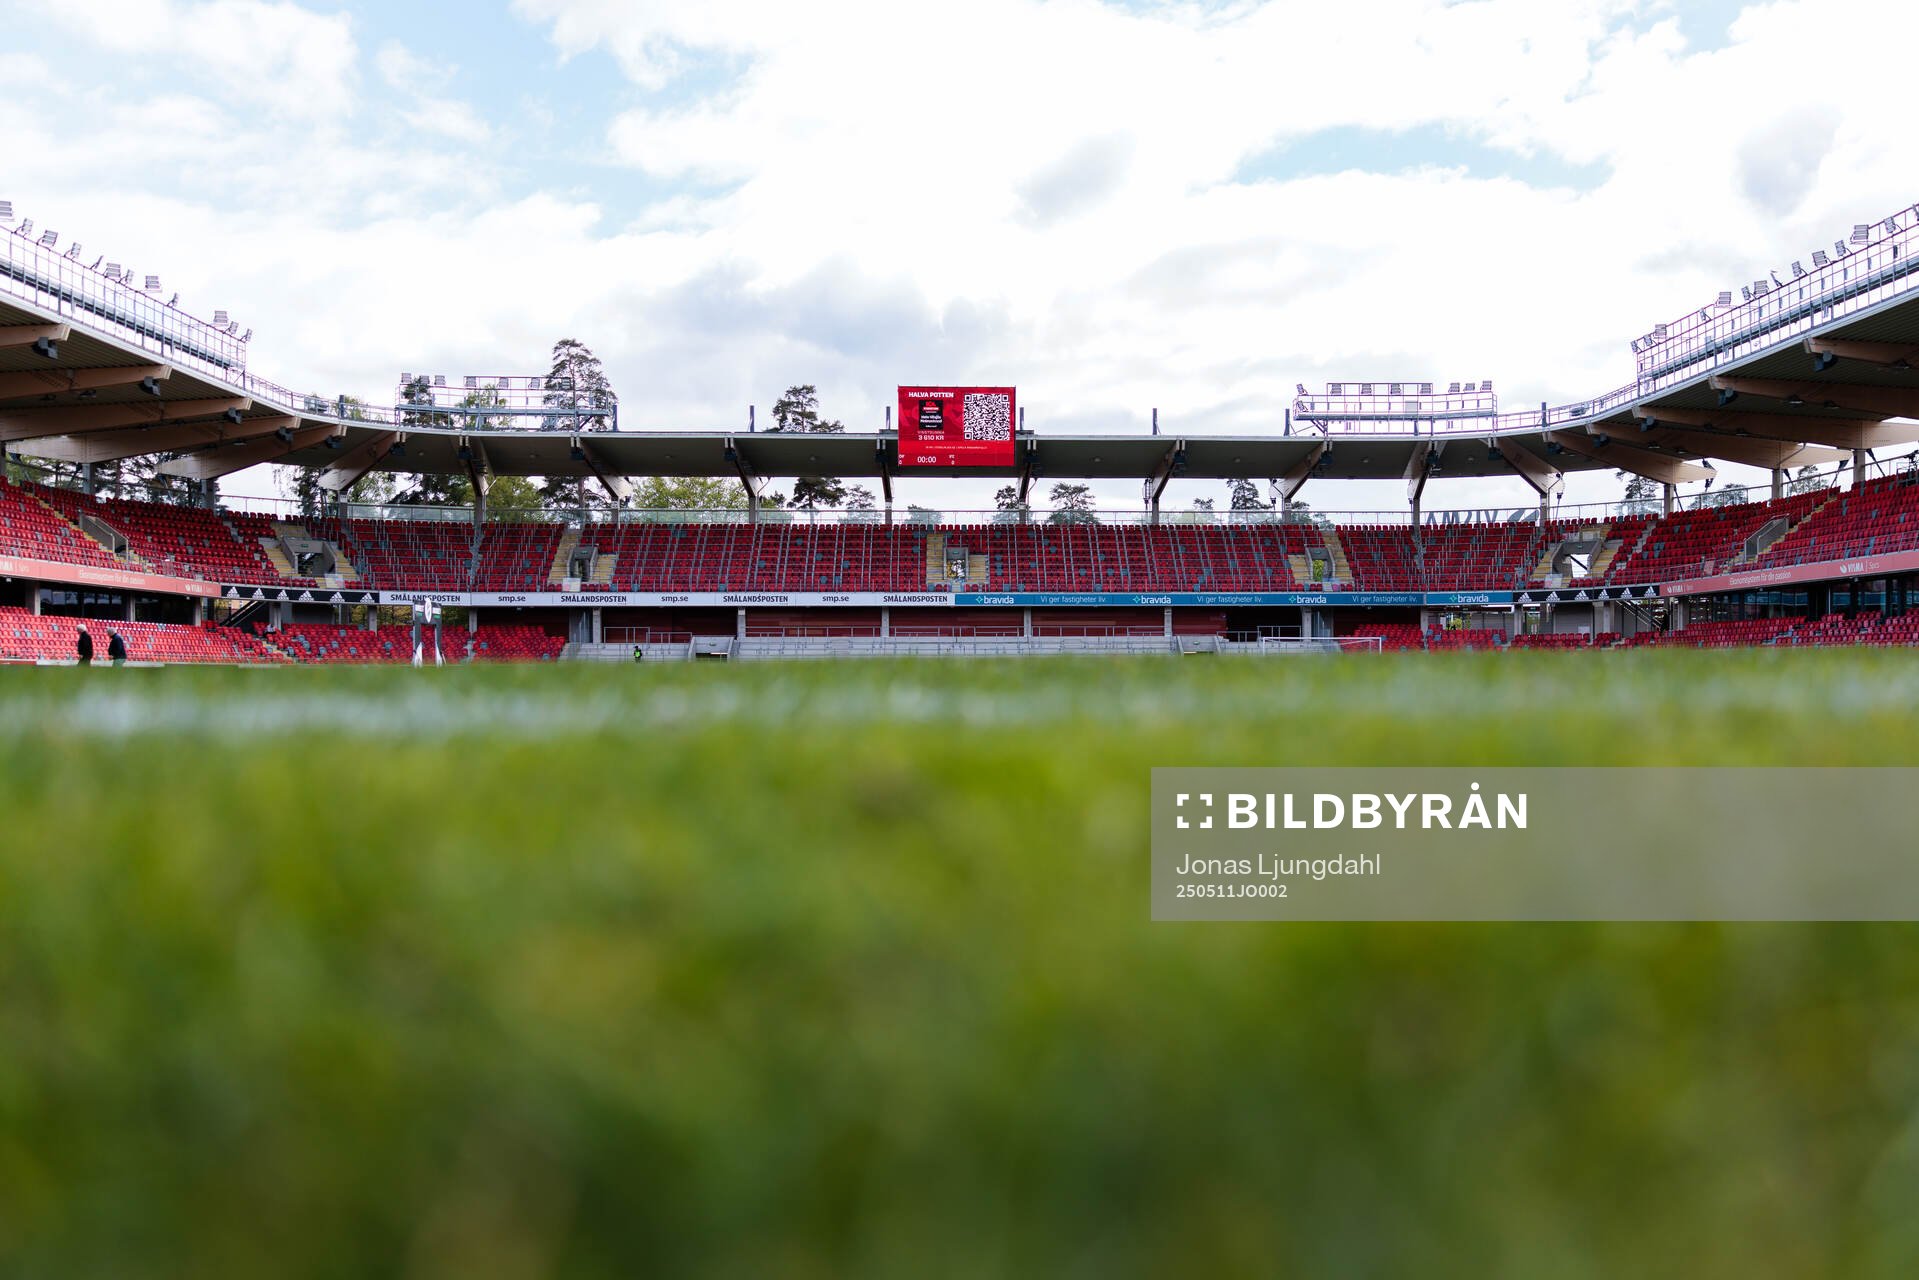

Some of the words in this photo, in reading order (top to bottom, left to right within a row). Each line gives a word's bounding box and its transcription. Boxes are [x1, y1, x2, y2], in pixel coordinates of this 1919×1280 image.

[917, 455, 937, 464] 00:00
[498, 595, 526, 603] smp.se
[560, 594, 627, 603] SMÅLANDSPOSTEN
[661, 594, 689, 603] smp.se
[723, 594, 789, 603] SMÅLANDSPOSTEN
[822, 594, 850, 603] smp.se
[883, 593, 948, 603] SMÅLANDSPOSTEN
[983, 594, 1015, 604] bravida
[1040, 595, 1047, 603] Vi
[1048, 597, 1060, 605] ger
[1061, 595, 1097, 605] fastigheter
[1140, 594, 1172, 604] bravida
[1196, 595, 1204, 603] Vi
[1205, 597, 1217, 605] ger
[1218, 595, 1253, 605] fastigheter
[1296, 594, 1327, 604] bravida
[1361, 596, 1372, 604] ger
[1373, 594, 1408, 604] fastigheter
[1457, 593, 1489, 603] bravida
